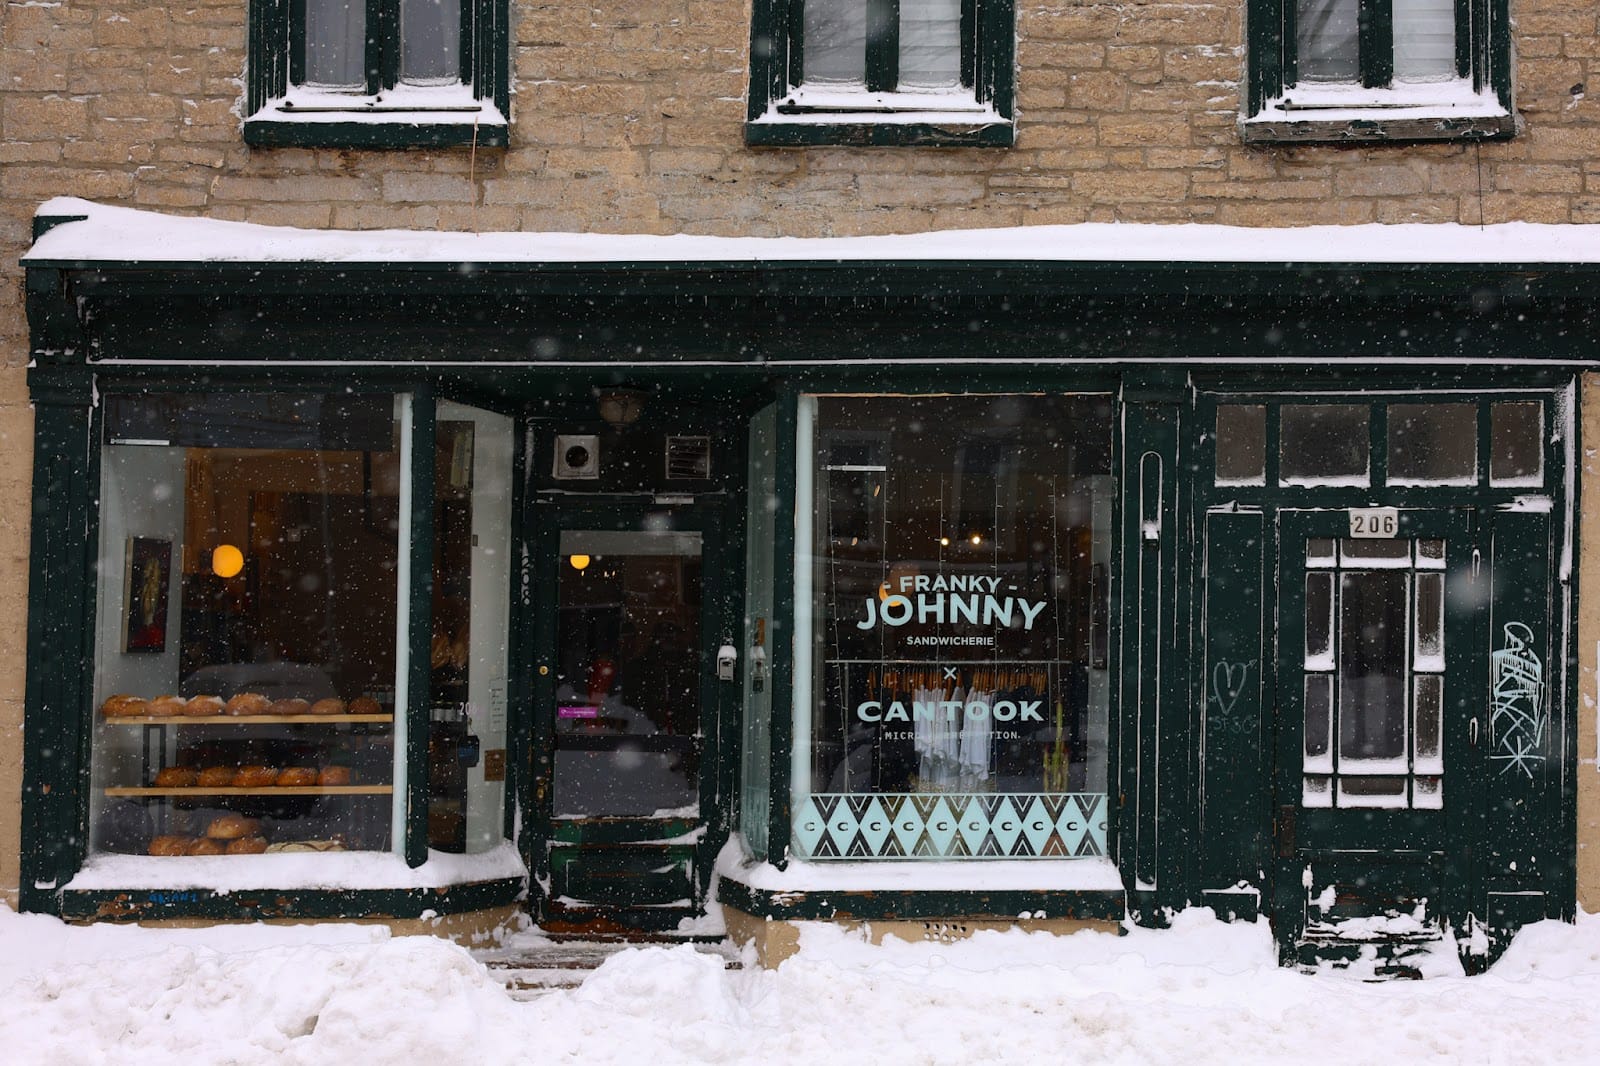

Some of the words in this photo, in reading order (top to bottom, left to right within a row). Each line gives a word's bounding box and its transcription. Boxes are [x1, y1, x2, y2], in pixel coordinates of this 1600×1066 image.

[1354, 516, 1393, 533] 206
[899, 575, 1002, 593] FRANKY
[856, 593, 1047, 630] JOHNNY
[906, 636, 994, 646] SANDWICHERIE
[857, 701, 1044, 722] CANTOOK
